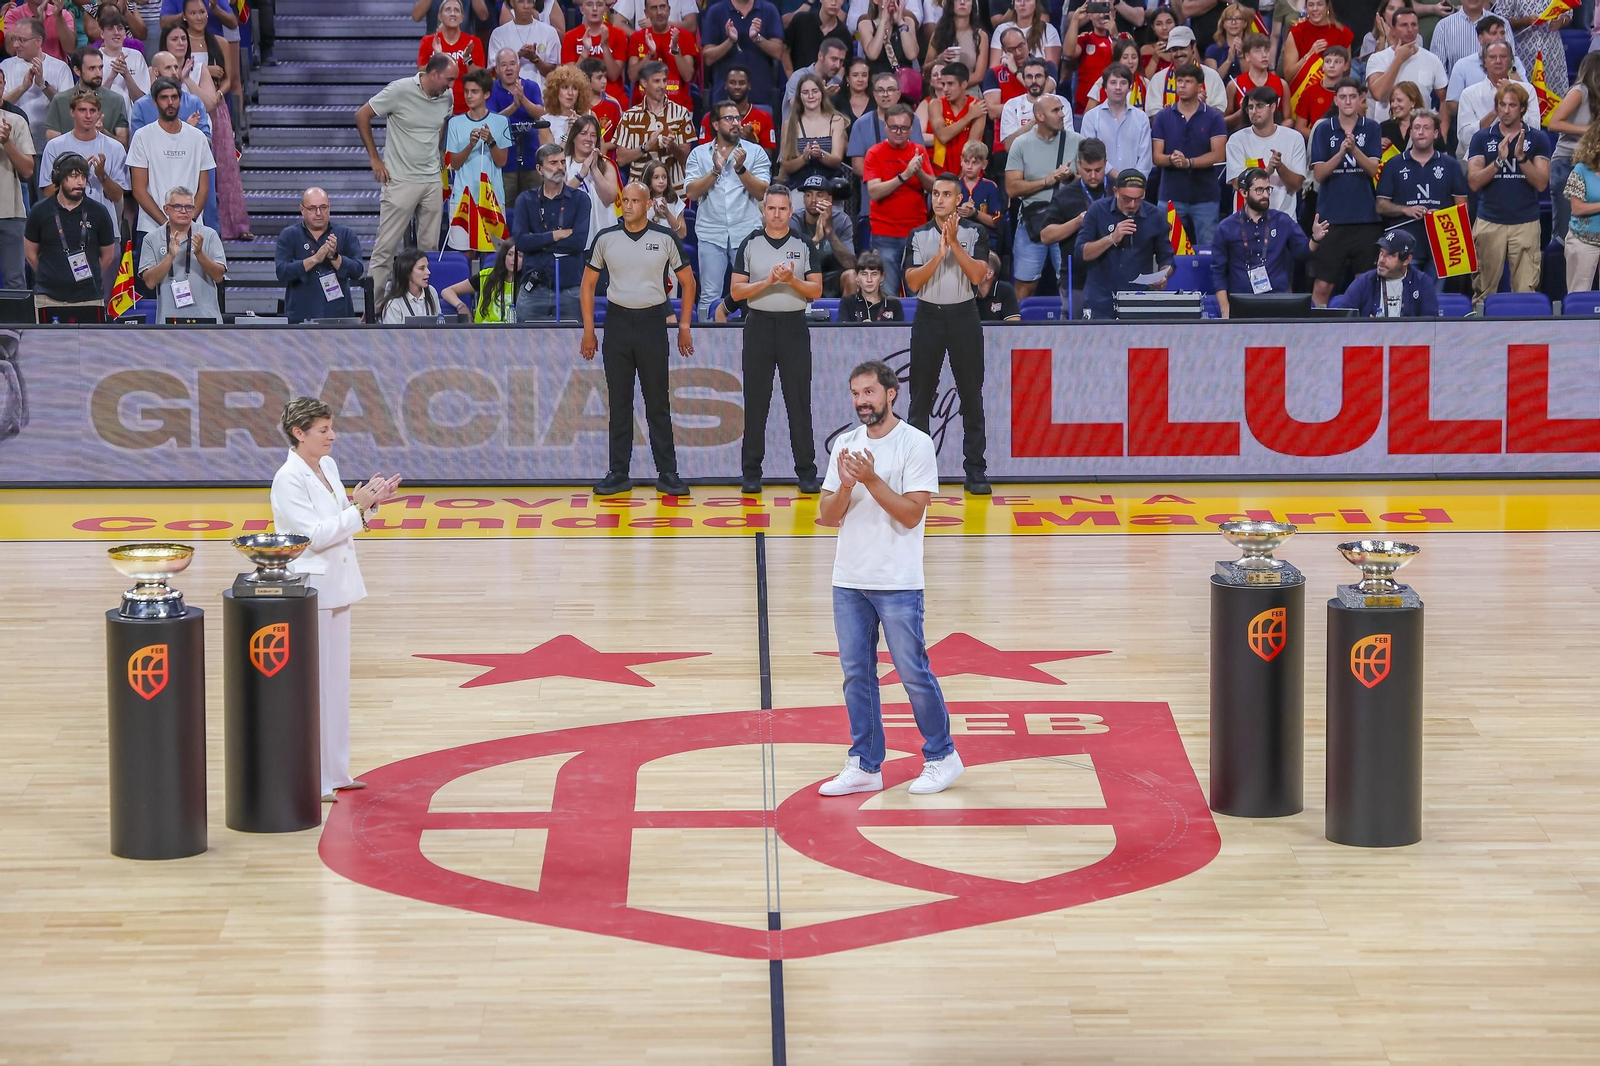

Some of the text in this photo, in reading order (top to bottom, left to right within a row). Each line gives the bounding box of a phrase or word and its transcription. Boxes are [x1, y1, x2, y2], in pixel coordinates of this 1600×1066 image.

[1437, 214, 1464, 268] ESPAÑA
[91, 368, 744, 449] GRACIAS
[1011, 343, 1600, 457] LLULL
[926, 493, 1197, 506] RENA
[72, 513, 771, 532] Counidad
[1013, 508, 1453, 526] Madrid
